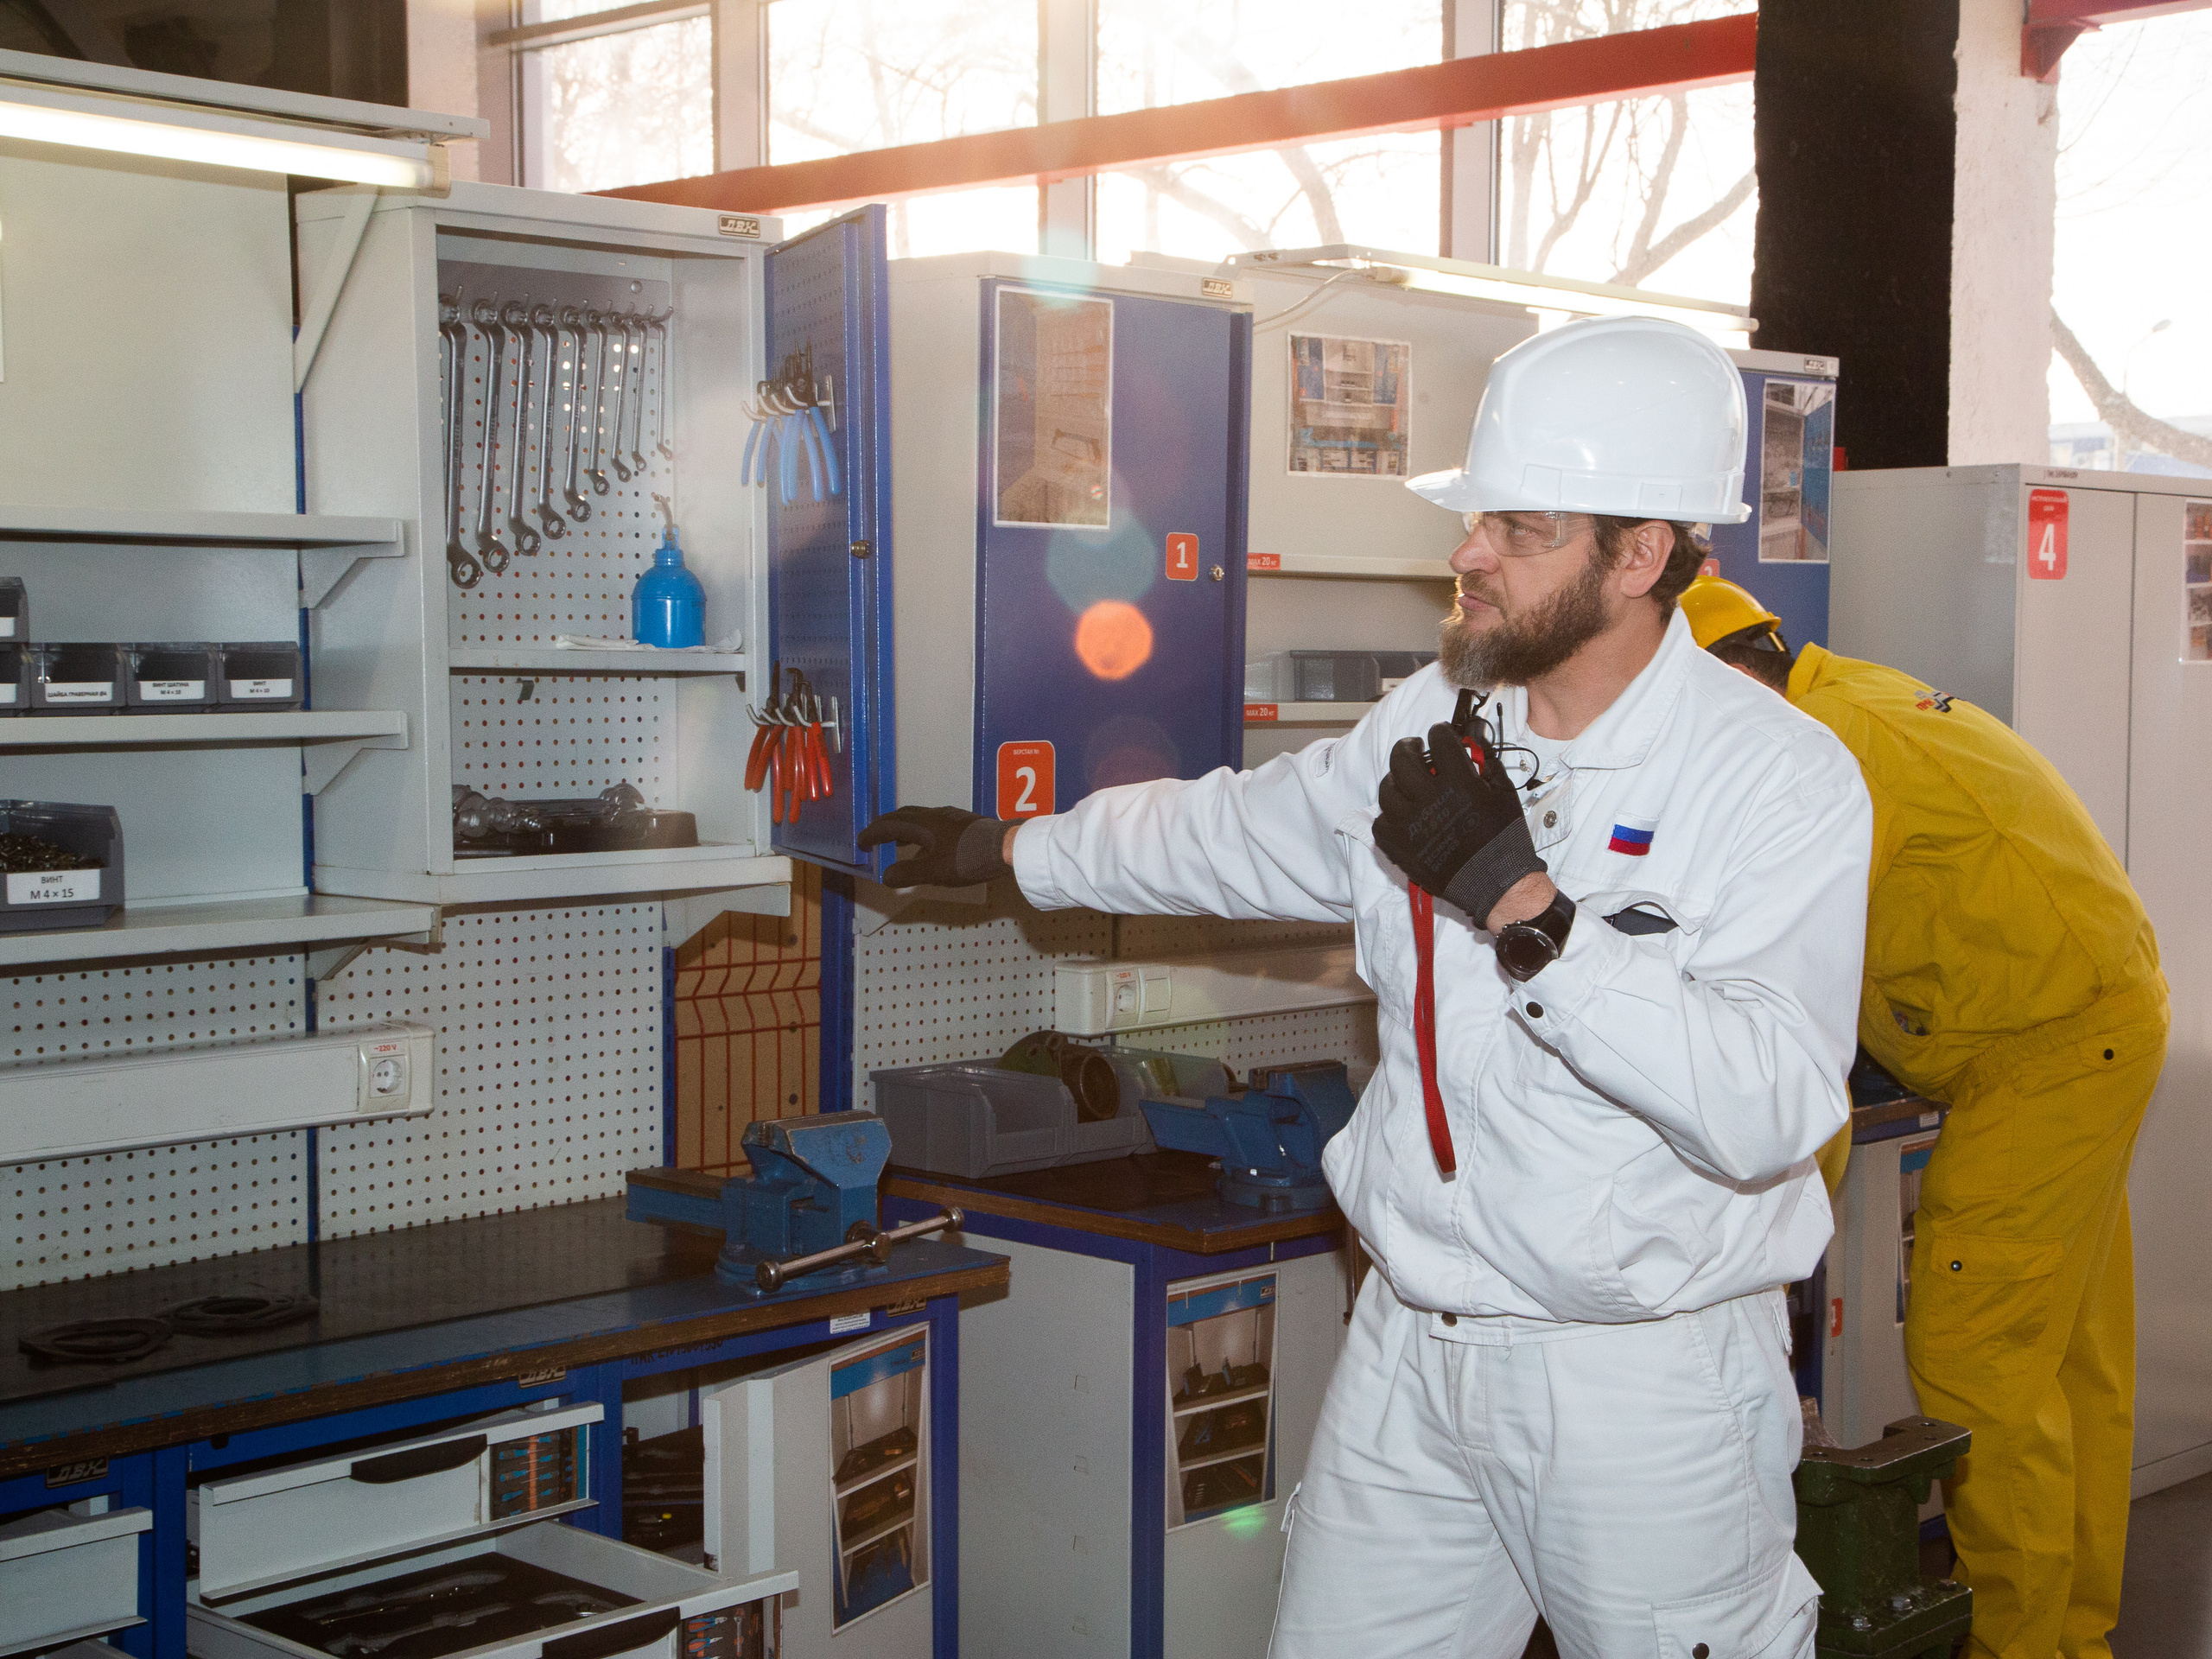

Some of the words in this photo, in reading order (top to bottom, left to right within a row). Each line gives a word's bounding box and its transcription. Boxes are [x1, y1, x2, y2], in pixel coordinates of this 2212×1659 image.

[2039, 524, 2056, 570] 4
[1176, 542, 1189, 569] 1
[1262, 556, 1270, 566] 20
[1259, 707, 1268, 716] 20
[1015, 766, 1037, 811] 2
[41, 875, 63, 884] ВИНТ
[43, 890, 49, 899] 4
[62, 888, 73, 898] 15
